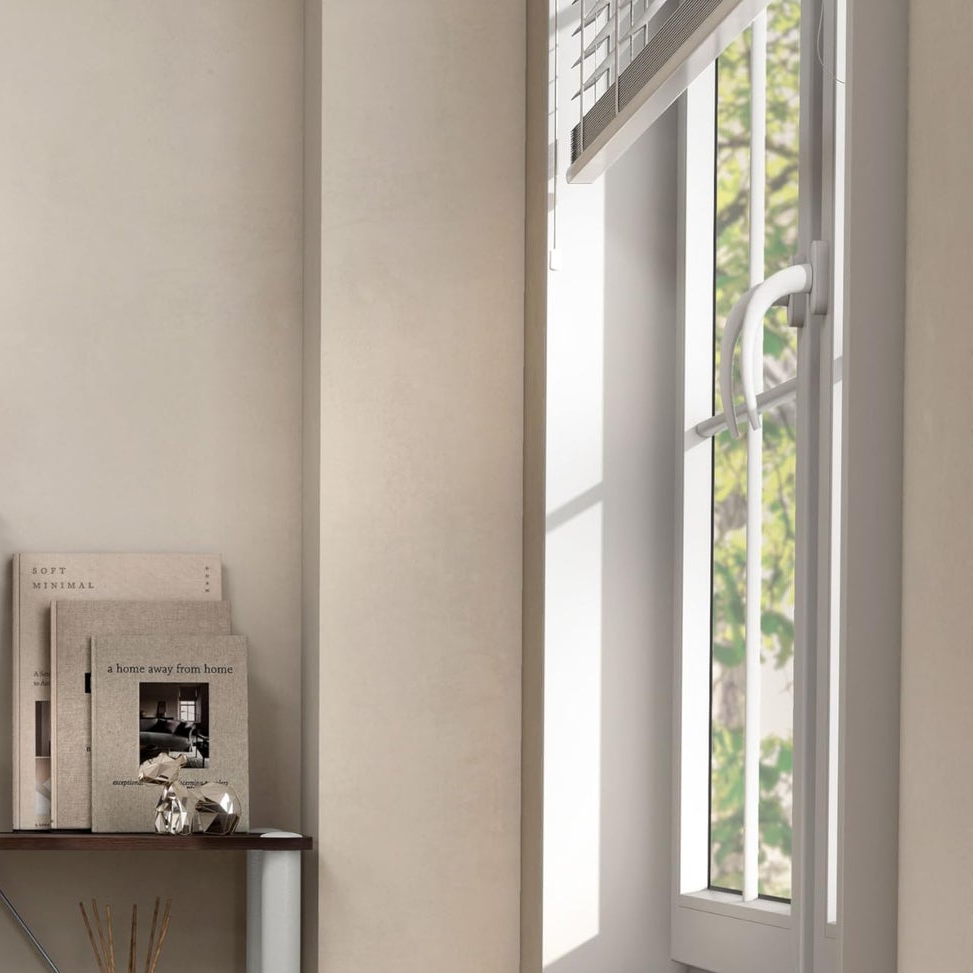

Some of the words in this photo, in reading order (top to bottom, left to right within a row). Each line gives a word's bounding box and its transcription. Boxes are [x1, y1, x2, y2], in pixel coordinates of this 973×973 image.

[32, 567, 66, 575] SOFT
[32, 582, 95, 590] MINIMAL
[107, 666, 113, 674] a
[116, 663, 145, 674] home
[148, 666, 173, 676] away
[176, 663, 201, 674] from
[204, 663, 233, 674] home
